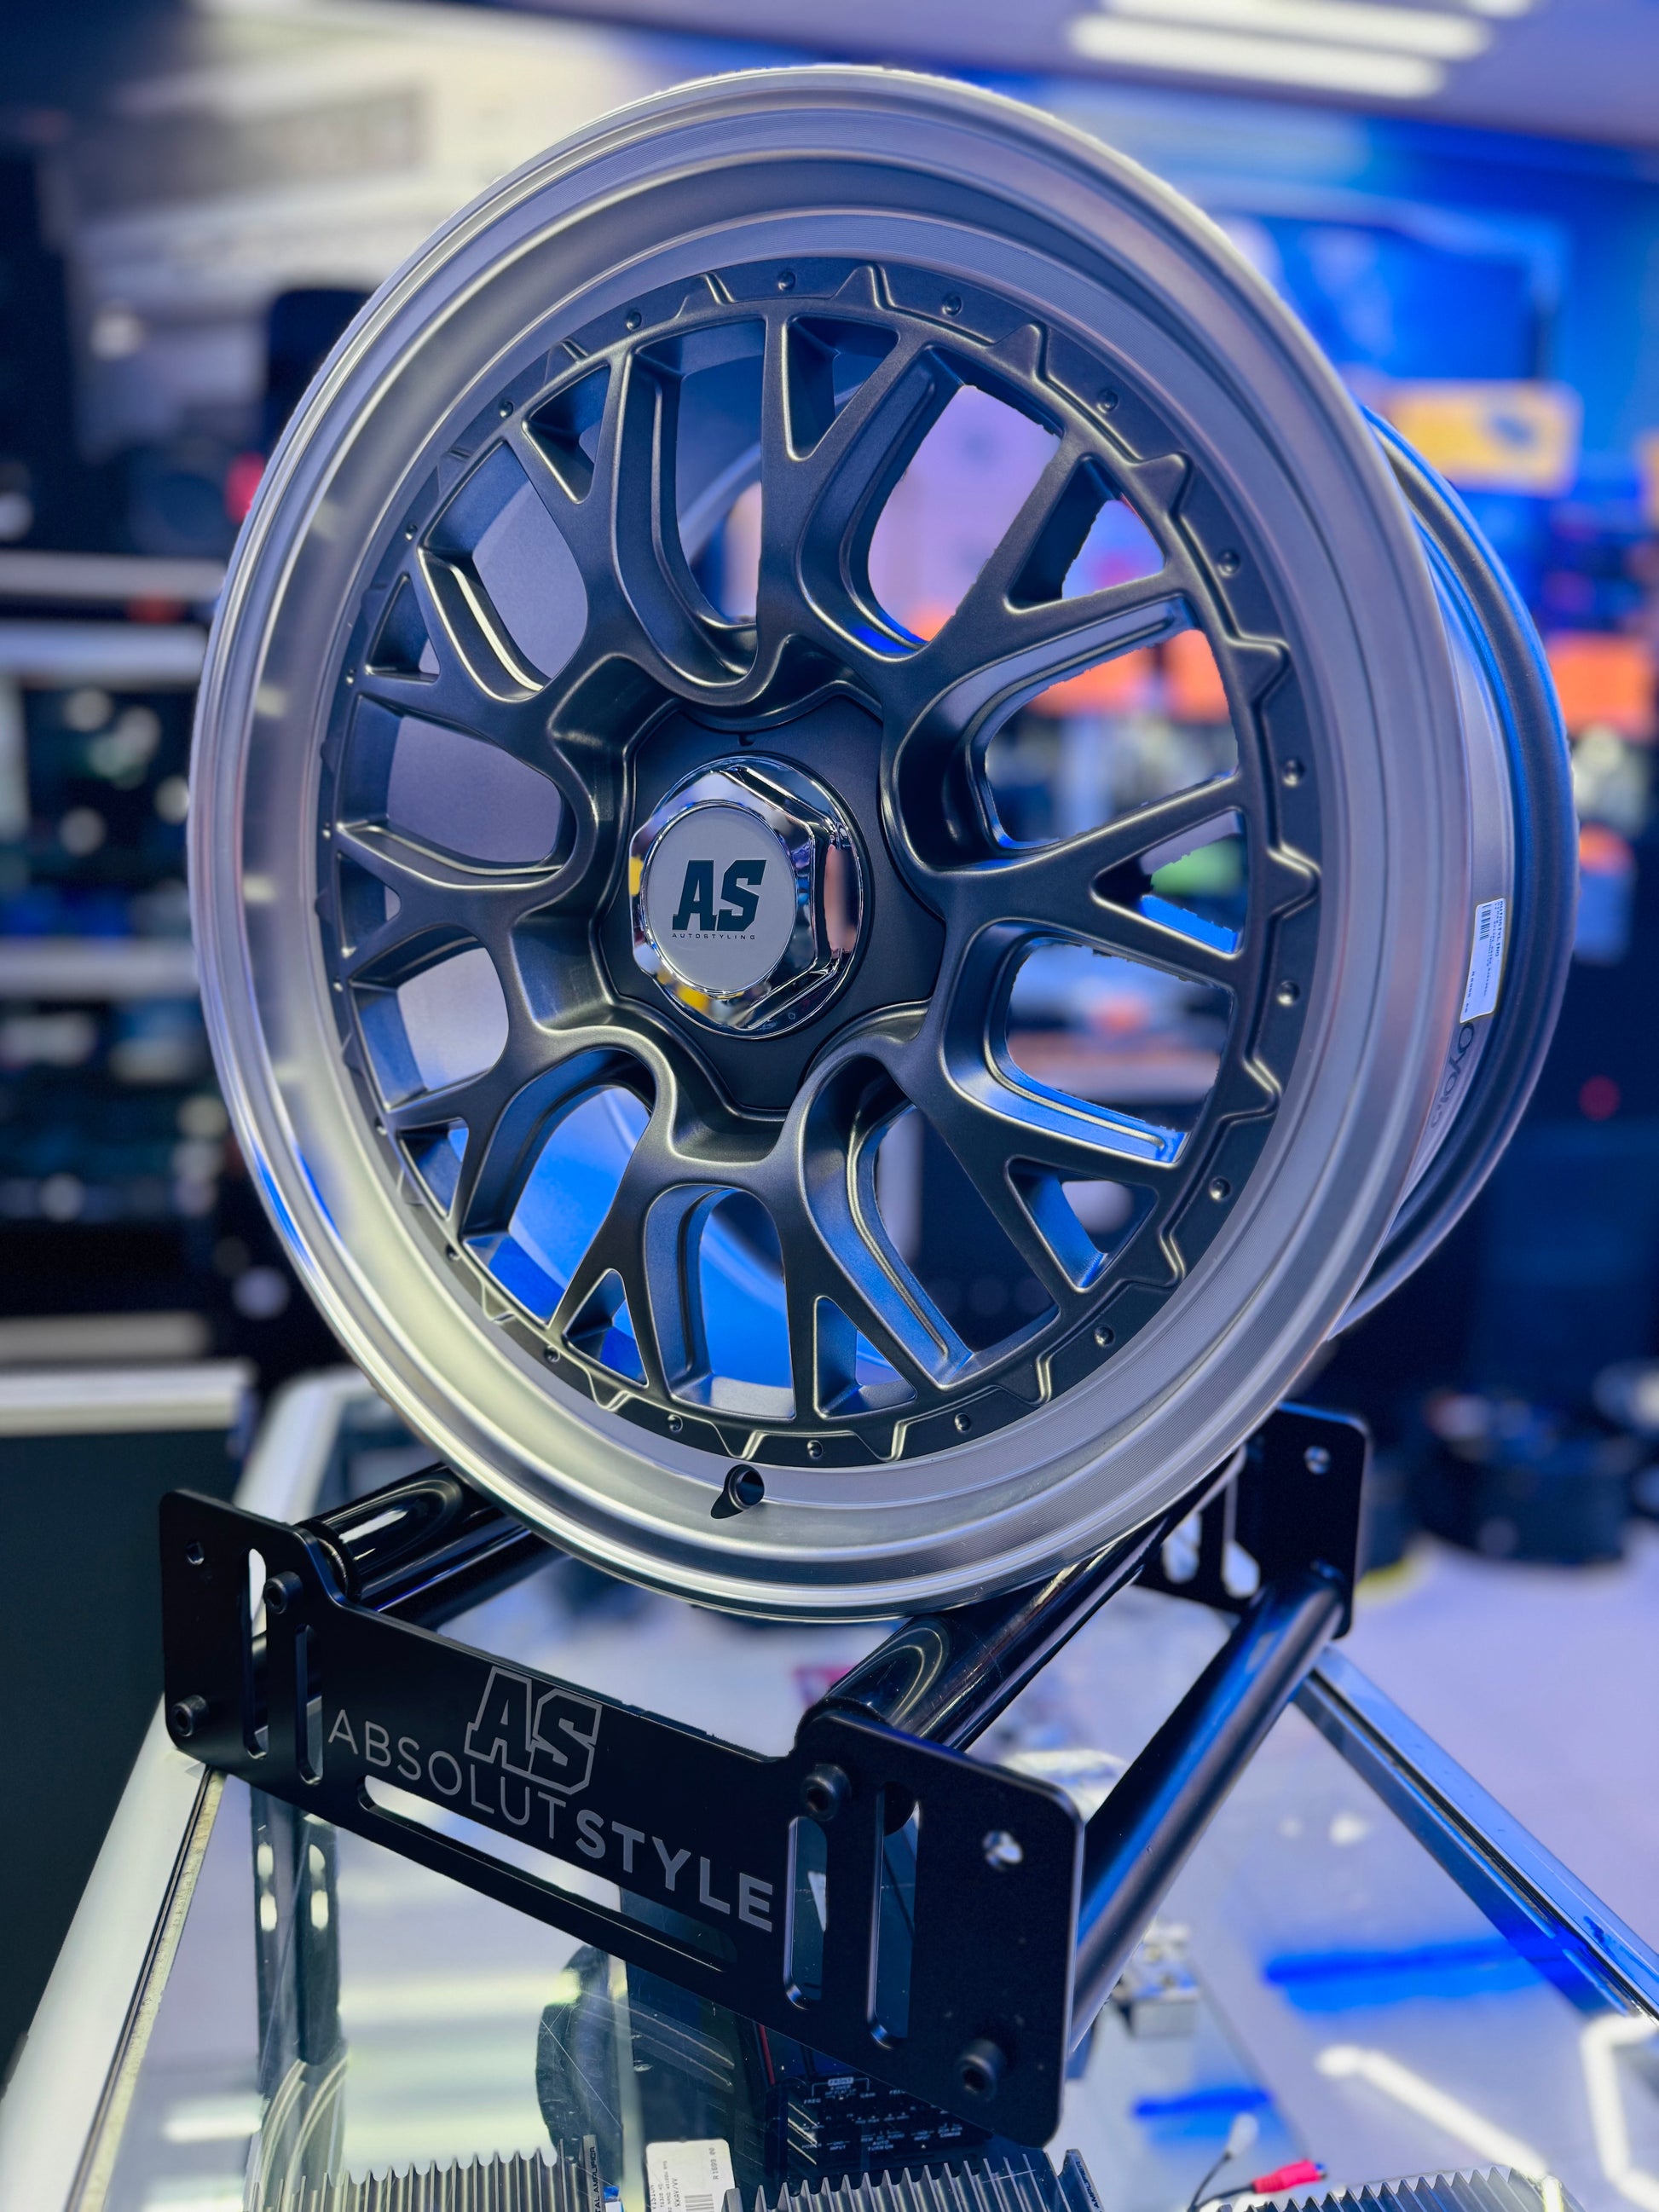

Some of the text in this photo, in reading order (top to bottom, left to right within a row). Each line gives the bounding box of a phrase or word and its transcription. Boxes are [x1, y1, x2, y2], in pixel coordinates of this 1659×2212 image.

[672, 859, 767, 932] AS
[464, 1665, 603, 1795] AS
[590, 2146, 599, 2193] AMPLIFIER
[1076, 2161, 1100, 2209] AMPLIFIER
